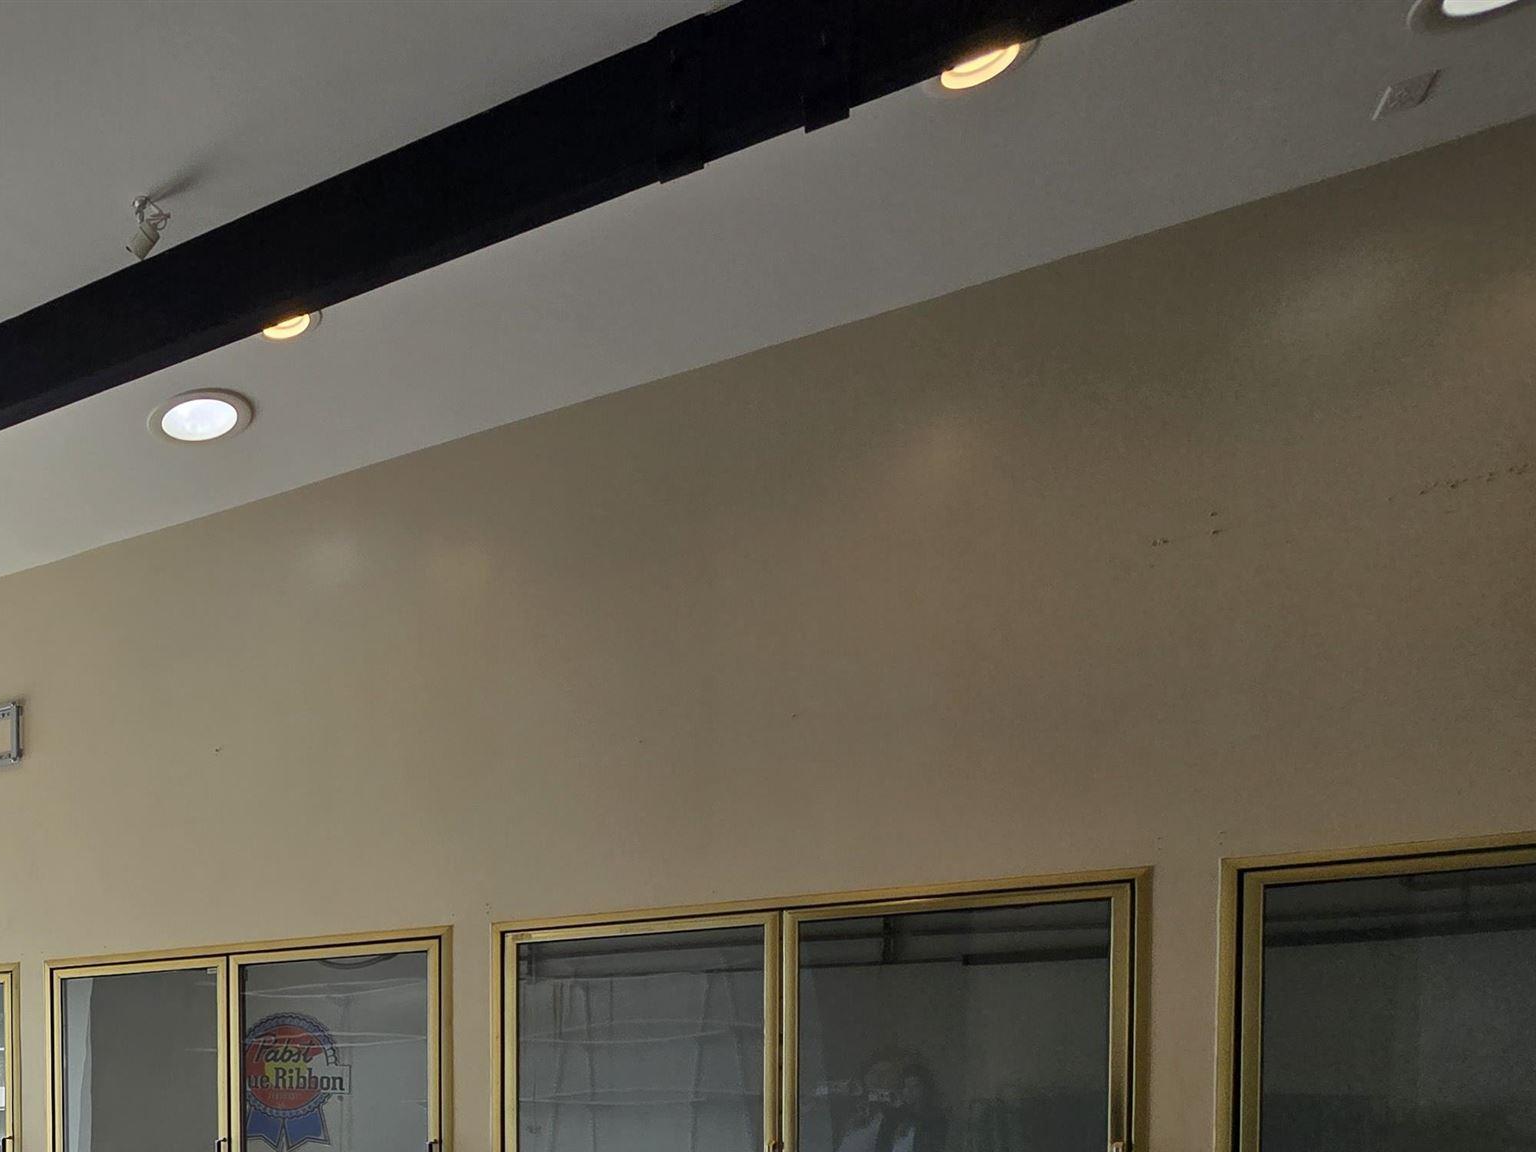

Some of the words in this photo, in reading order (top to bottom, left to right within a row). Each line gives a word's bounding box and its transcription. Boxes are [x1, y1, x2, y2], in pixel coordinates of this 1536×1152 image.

[251, 1032, 317, 1064] Pabst
[247, 1073, 270, 1090] ue
[273, 1067, 345, 1091] Ribbon
